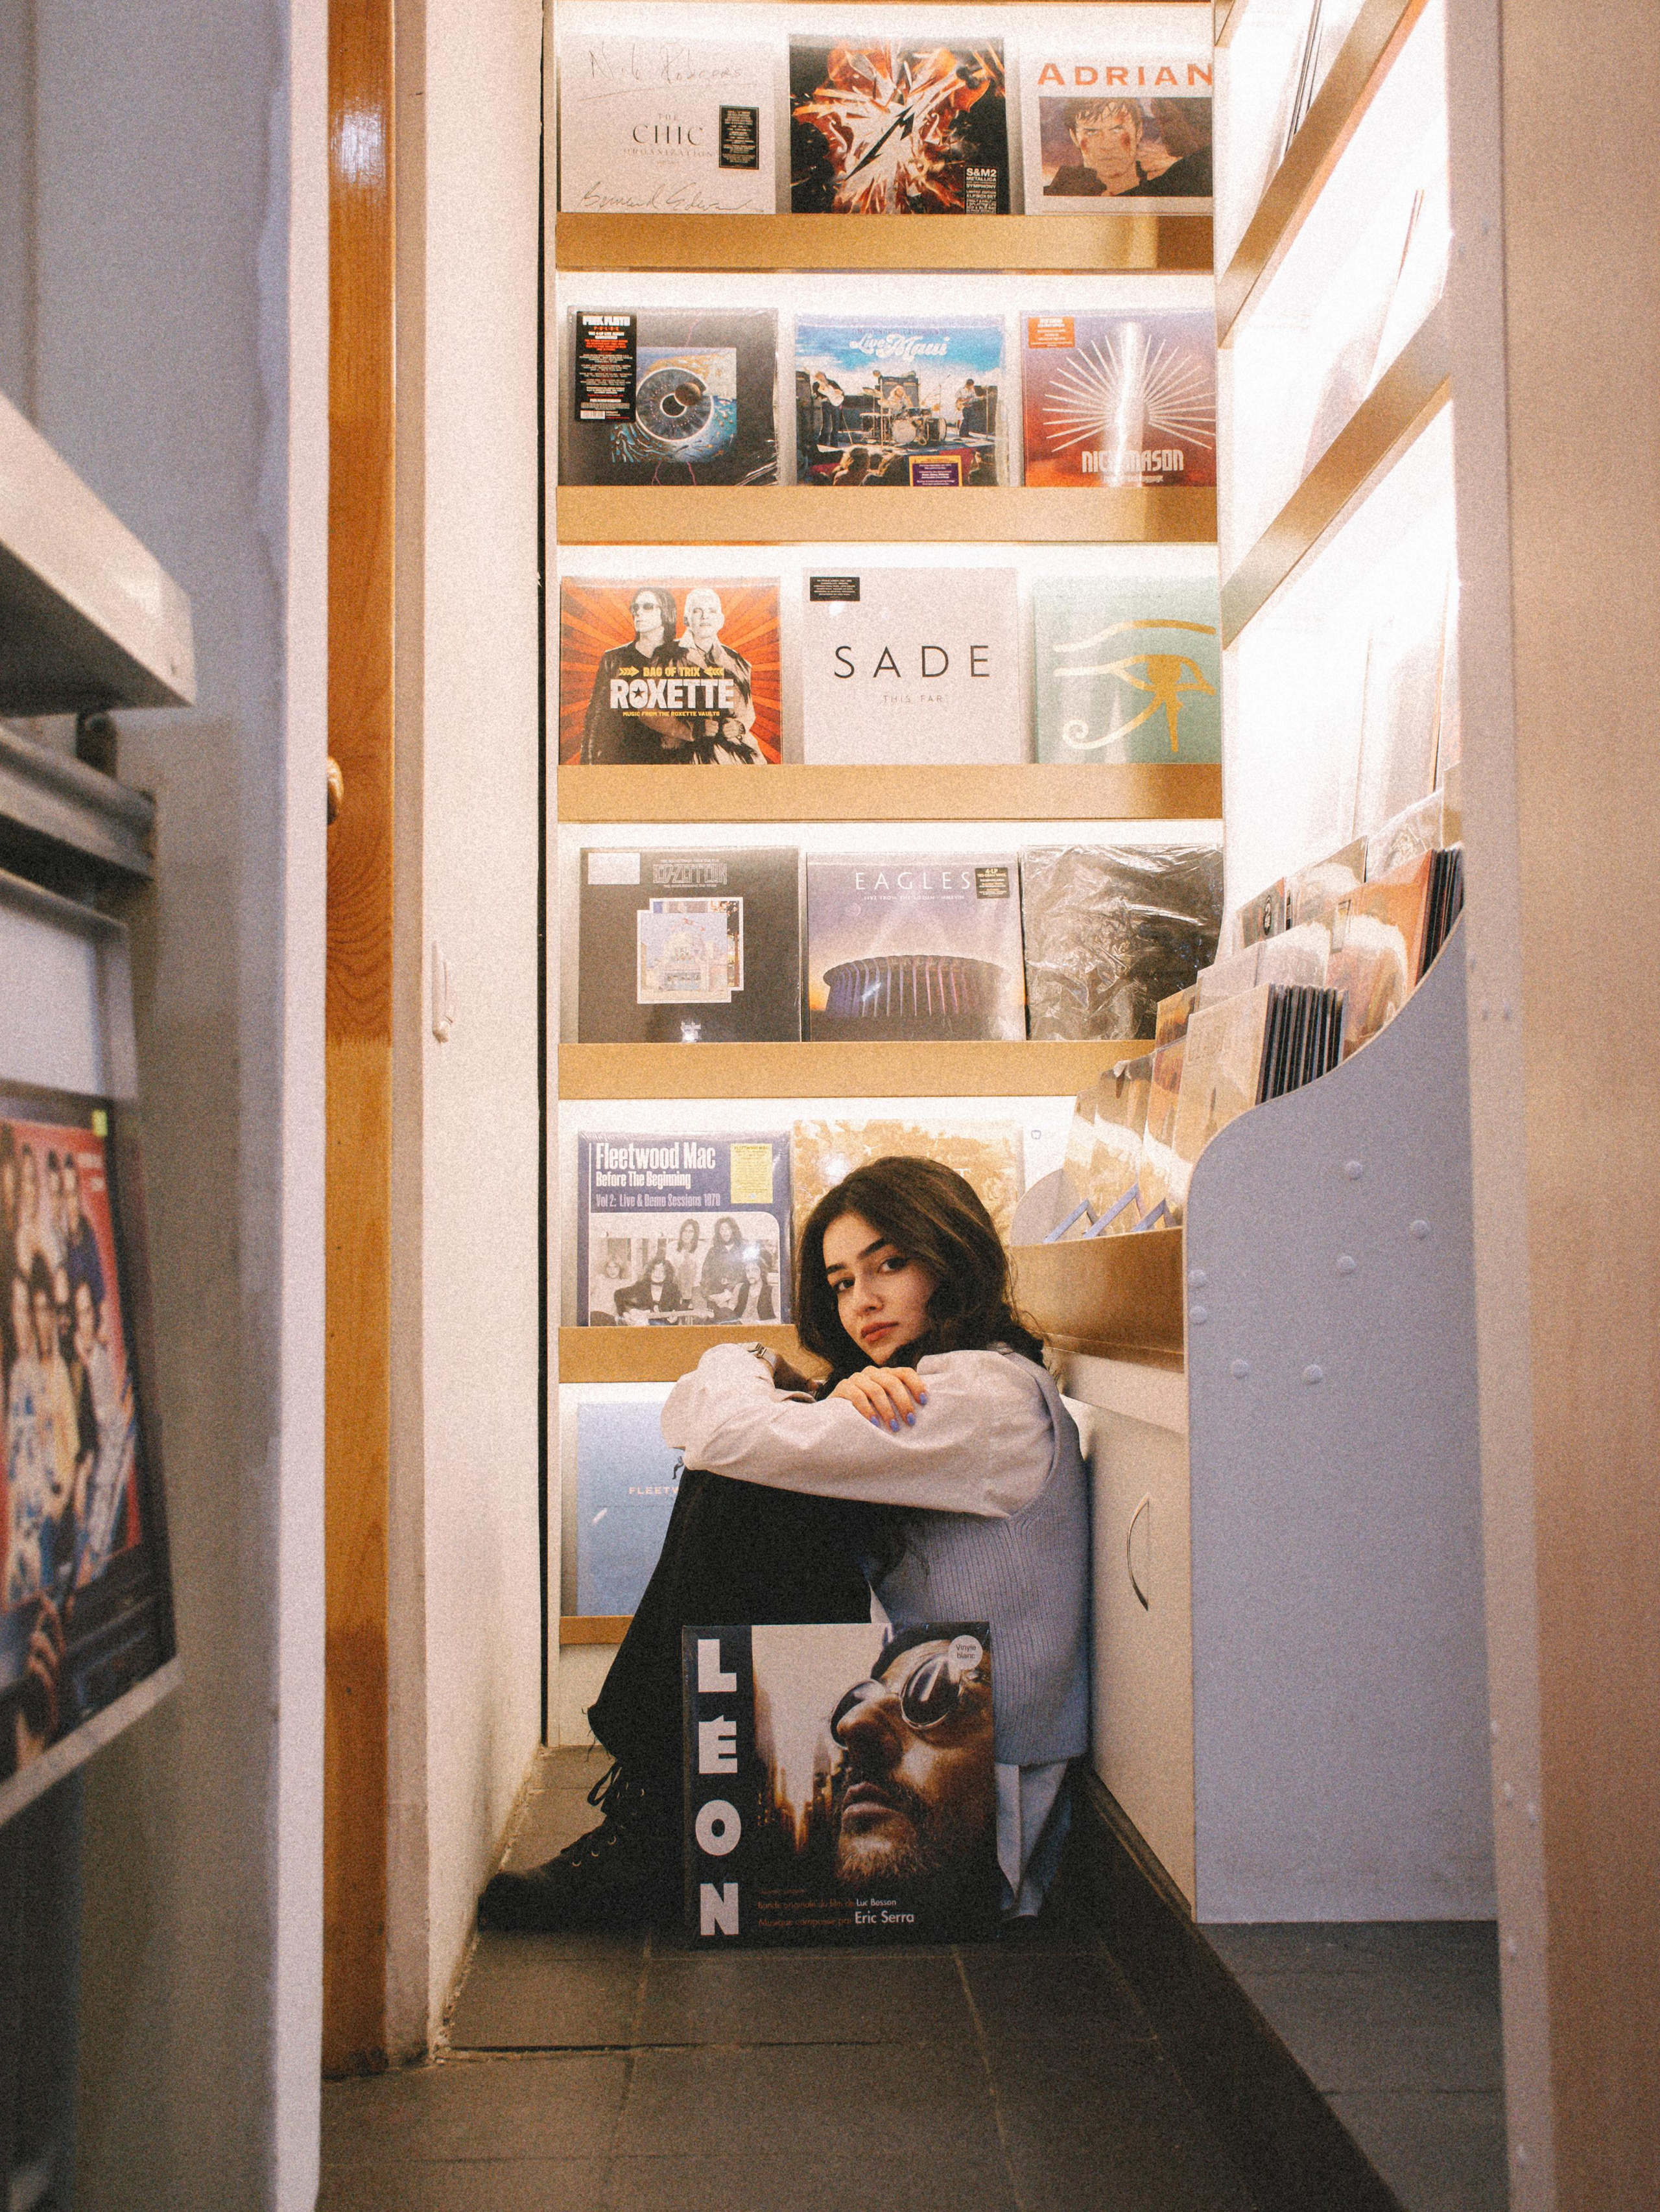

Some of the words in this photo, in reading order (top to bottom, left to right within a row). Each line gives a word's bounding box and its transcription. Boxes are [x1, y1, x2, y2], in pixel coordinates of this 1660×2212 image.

[1038, 63, 1213, 86] ADRIAN
[633, 125, 704, 146] CHIC
[966, 167, 997, 177] S&M2
[1082, 450, 1121, 473] NIC
[643, 667, 661, 677] BAG
[665, 666, 676, 677] OF
[680, 666, 700, 677] TRIX
[834, 645, 990, 679] SADE
[610, 679, 734, 709] ROXETTE
[920, 694, 943, 703] FAR
[856, 871, 970, 890] EAGLES
[596, 1142, 680, 1170] Fleetwood
[683, 1142, 716, 1169] Mac
[596, 1171, 626, 1187] Before
[628, 1171, 644, 1187] The
[646, 1171, 691, 1190] Beginning
[596, 1194, 608, 1207] Vol
[619, 1194, 636, 1207] Live
[668, 1194, 702, 1206] Sessions
[856, 1898, 868, 1907] Luc
[871, 1898, 897, 1907] Besson
[855, 1910, 877, 1924] Eric
[881, 1910, 915, 1924] Serra
